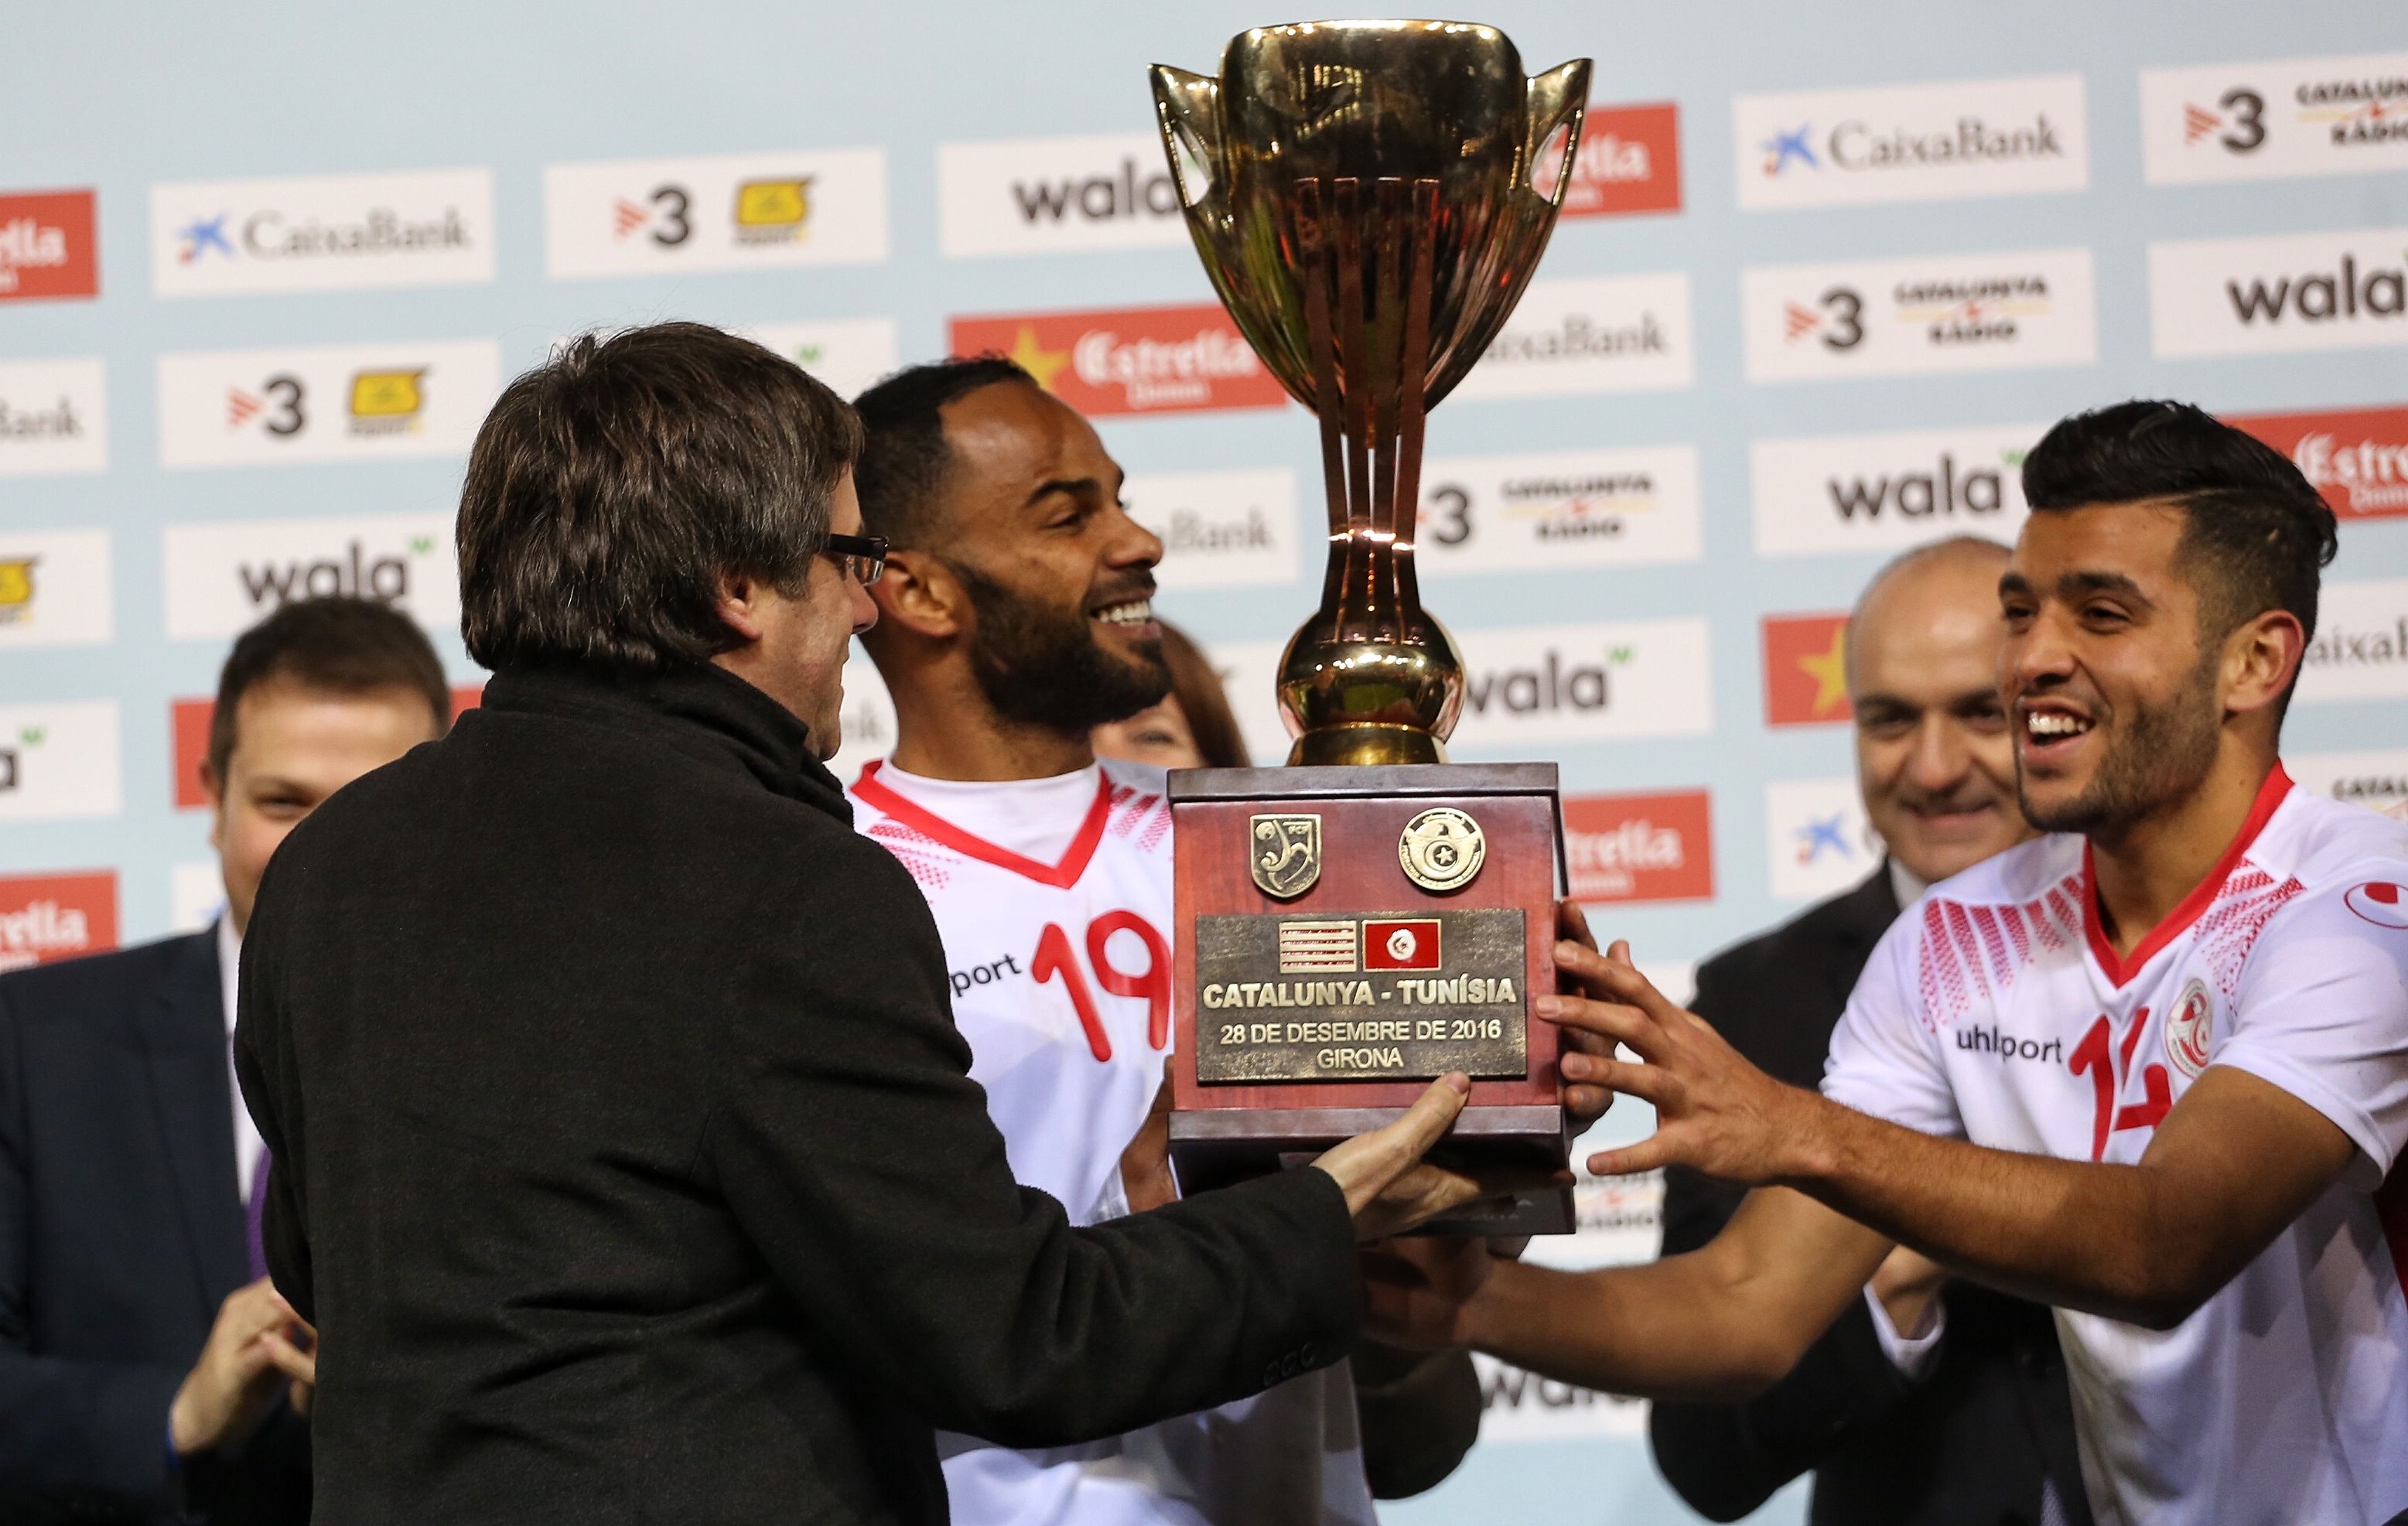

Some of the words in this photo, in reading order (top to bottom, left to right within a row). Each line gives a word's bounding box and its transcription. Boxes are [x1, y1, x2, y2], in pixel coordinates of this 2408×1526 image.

[1829, 114, 2064, 169] CaixaBank
[242, 206, 470, 261] CaixaBank
[1893, 275, 2050, 302] CATALUNYA
[2227, 253, 2407, 326] wala
[1073, 328, 1259, 386] Estrella
[1828, 458, 2002, 521] wala
[951, 952, 1022, 997] port
[1031, 910, 1172, 1062] 19
[1201, 980, 1375, 1007] CATALUNYA
[1397, 974, 1517, 1005] TUNÍSIA
[1220, 1024, 1246, 1044] 28
[1250, 1023, 1282, 1043] DE
[1286, 1021, 1410, 1042] DESEMBRE
[1416, 1019, 1446, 1040] DE
[1451, 1019, 1501, 1040] 2016
[1955, 1025, 2062, 1063] uhlport
[1316, 1047, 1404, 1069] GIRONA
